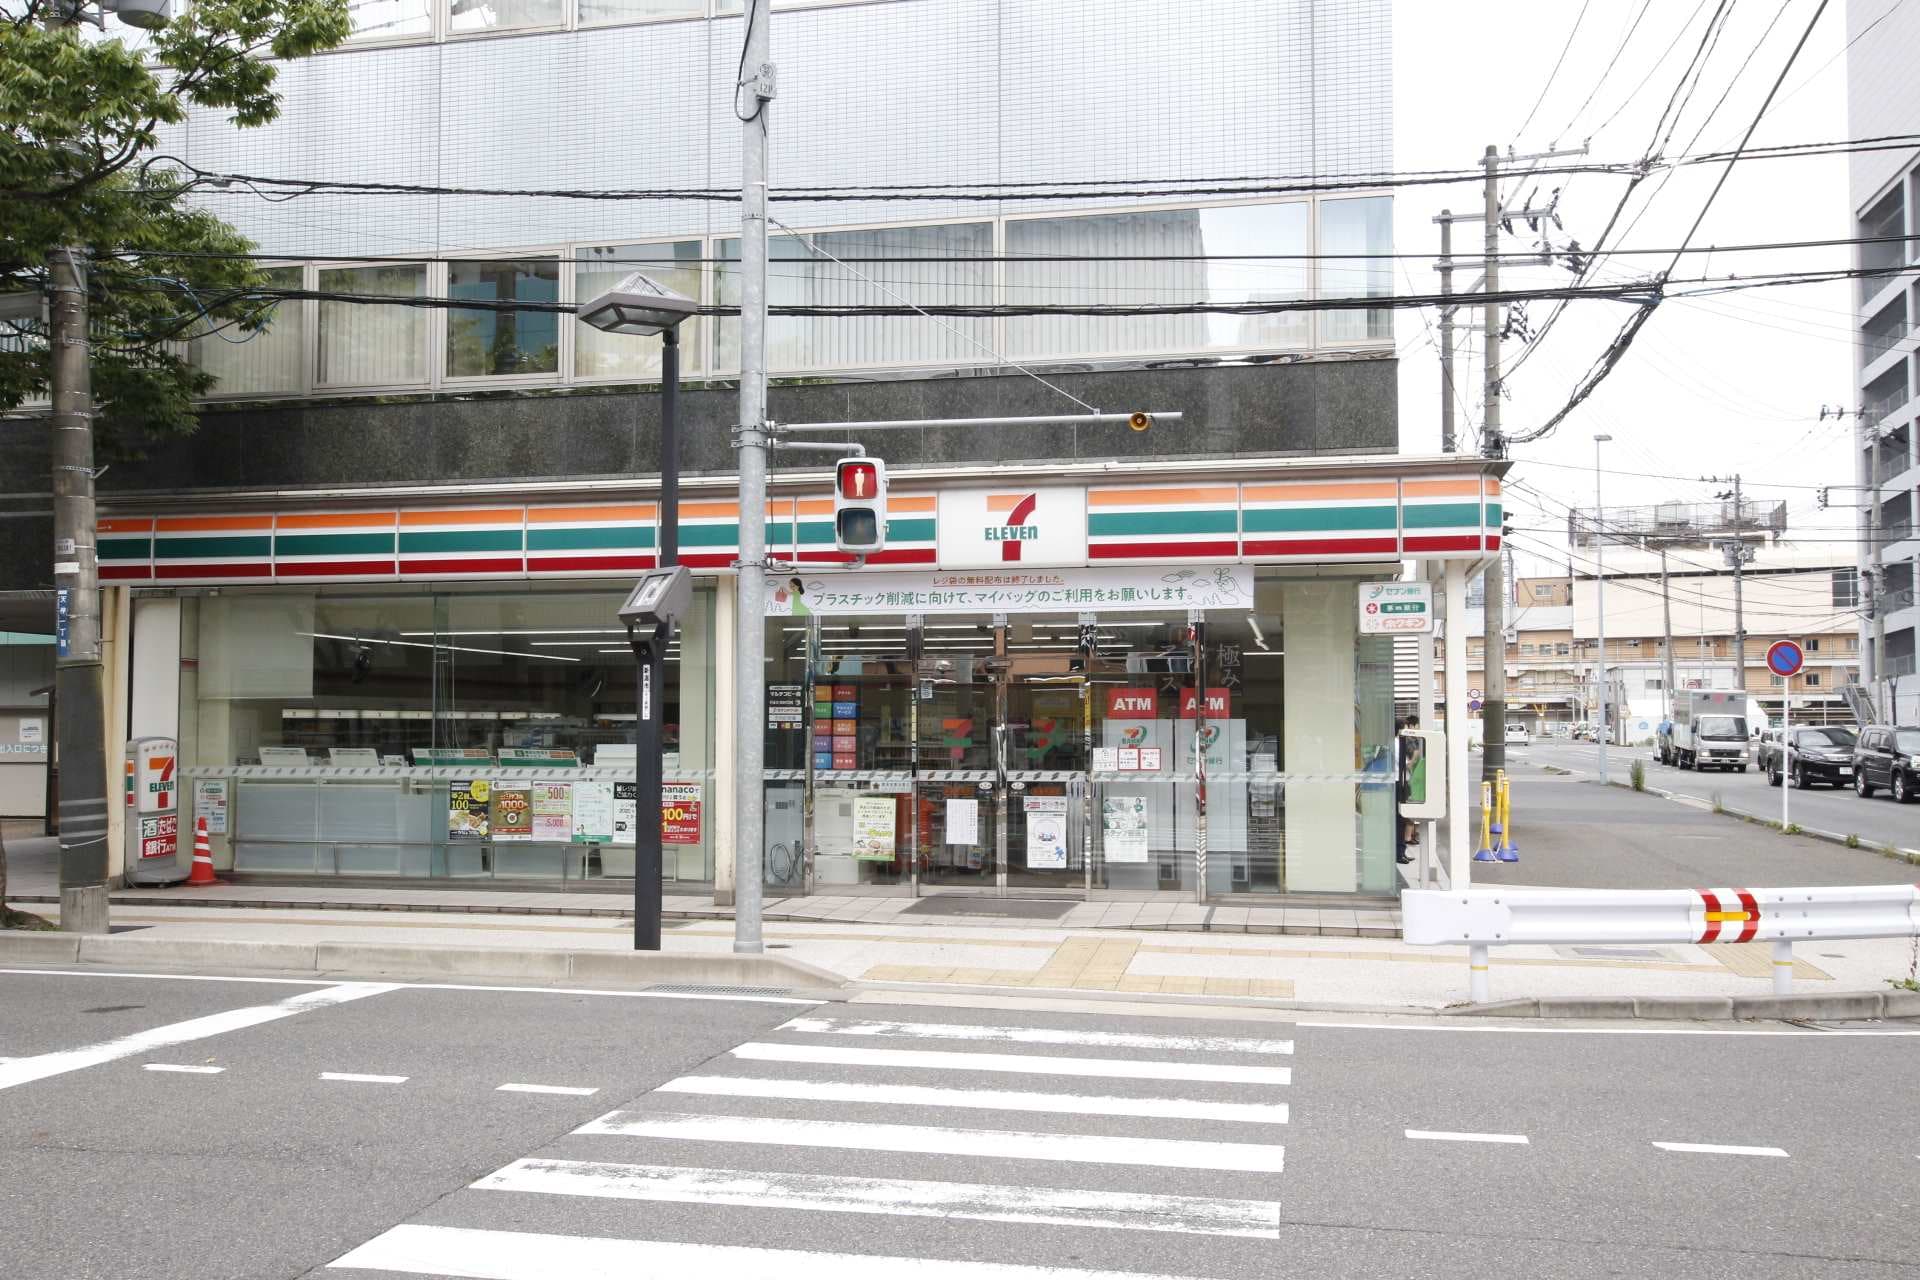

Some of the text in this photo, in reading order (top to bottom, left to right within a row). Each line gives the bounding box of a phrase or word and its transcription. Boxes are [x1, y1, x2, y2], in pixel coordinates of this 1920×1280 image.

[933, 575, 1064, 585] レジ袋の無料配布は終了しました。
[813, 586, 1193, 606] プラスチック削減に向けて、マイバッグのご利用をお願いします。
[1113, 697, 1151, 711] ATM
[1186, 697, 1224, 711] AM
[143, 819, 157, 837] 酒
